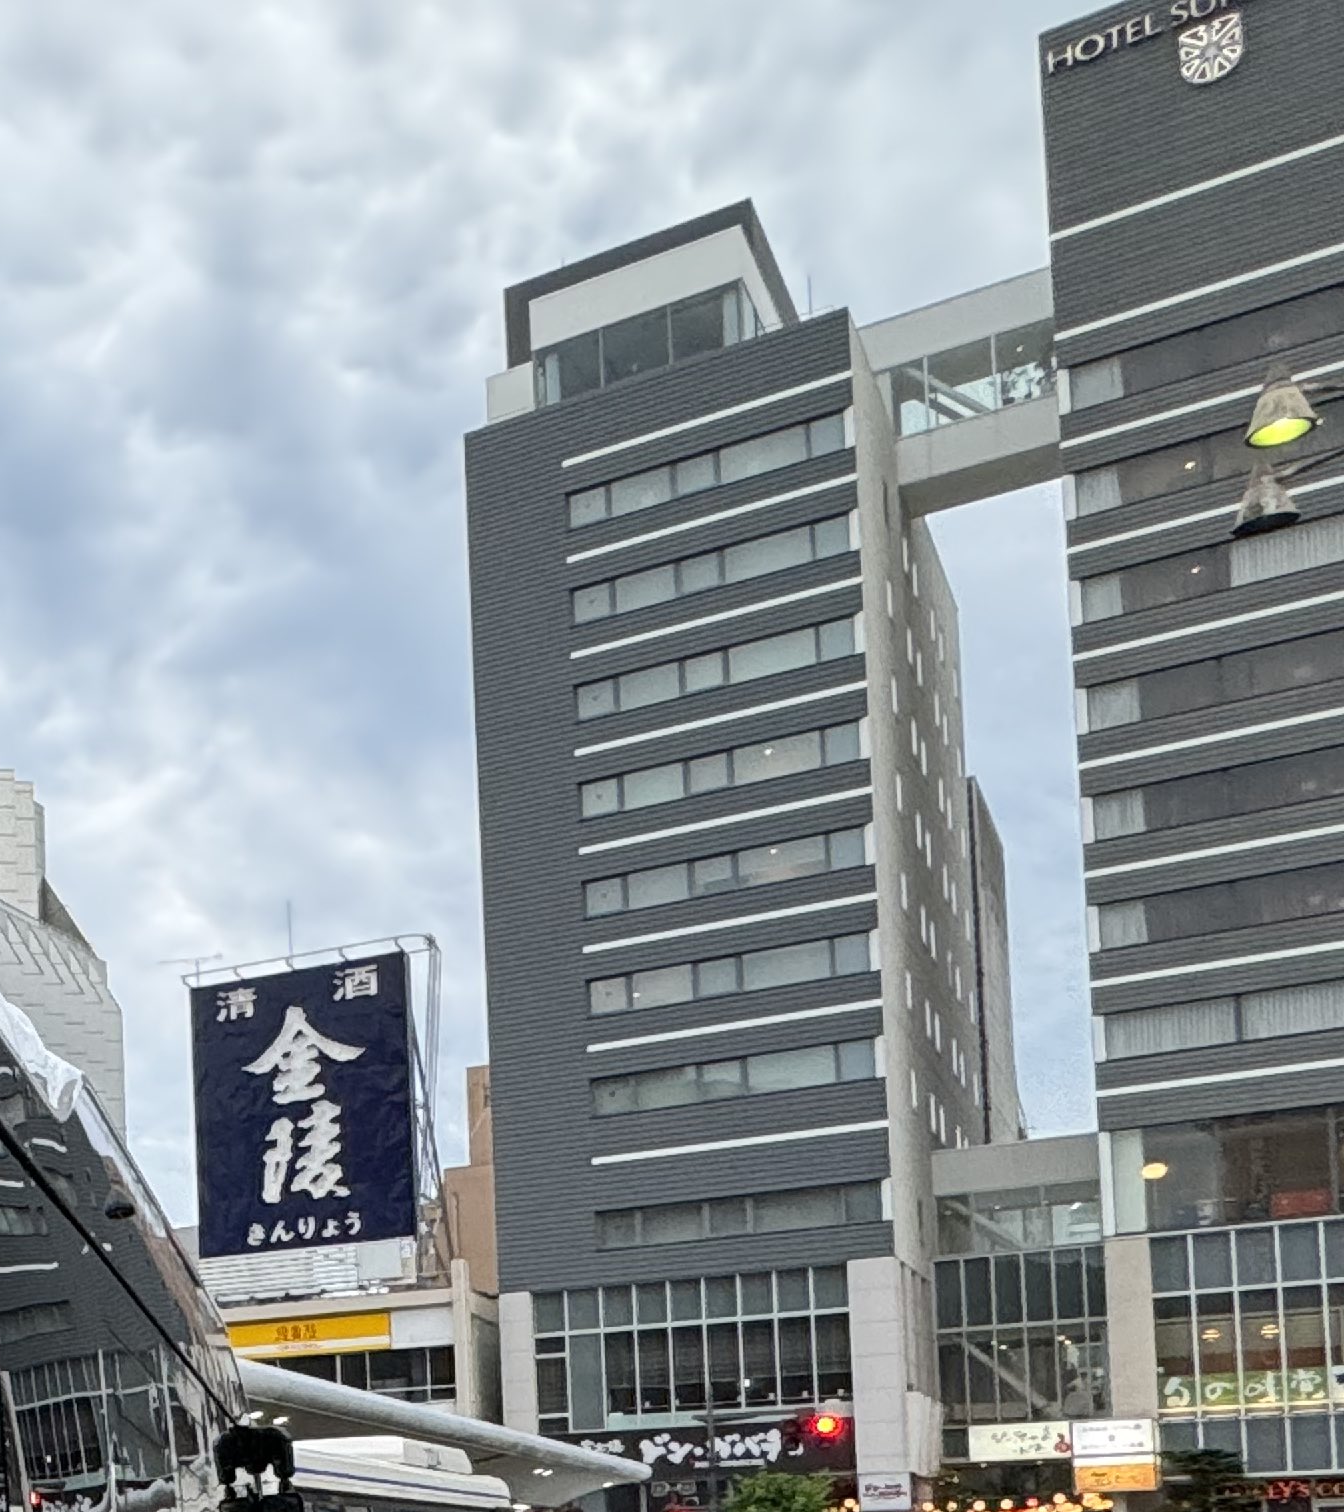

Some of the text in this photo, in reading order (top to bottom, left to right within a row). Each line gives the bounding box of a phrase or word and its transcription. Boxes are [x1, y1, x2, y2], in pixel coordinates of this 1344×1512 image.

[1047, 13, 1162, 75] HOTEL
[246, 1210, 362, 1246] きんりょう
